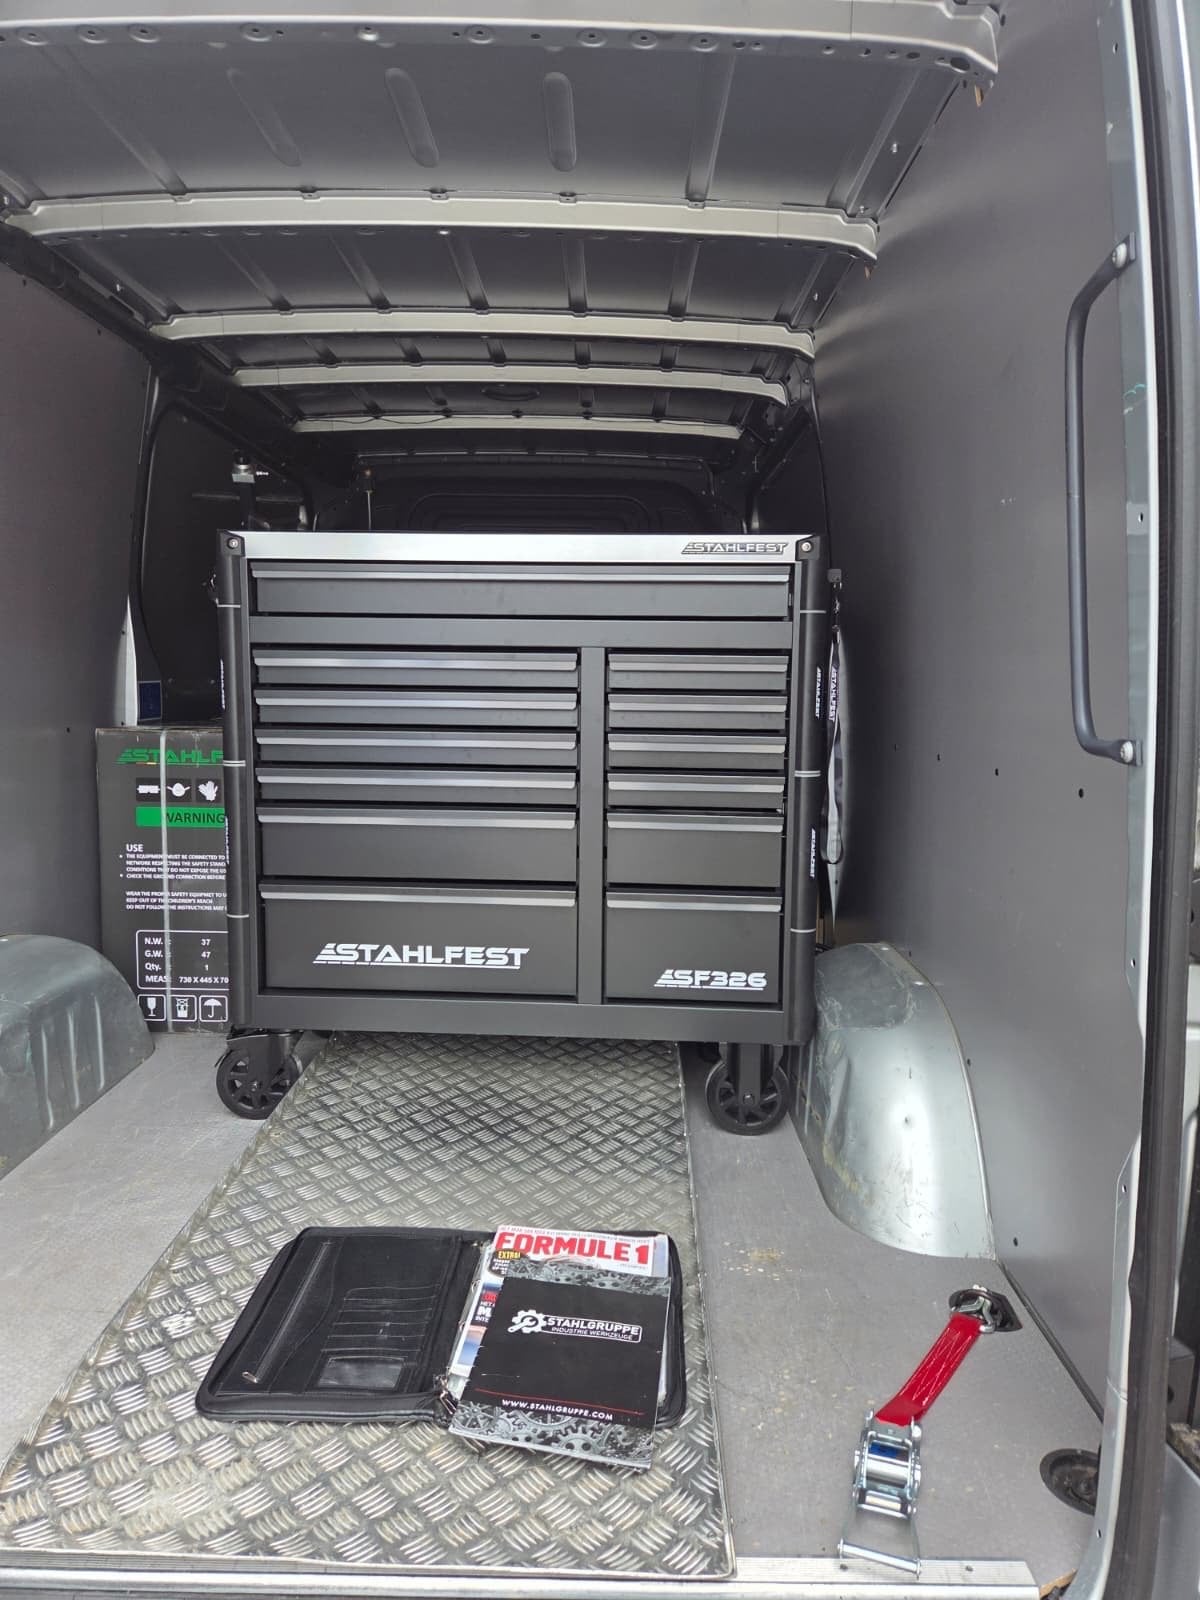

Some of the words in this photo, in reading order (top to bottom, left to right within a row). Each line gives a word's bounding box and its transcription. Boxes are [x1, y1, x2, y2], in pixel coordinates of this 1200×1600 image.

[681, 542, 788, 555] STAHLFEST
[126, 843, 144, 852] USE
[200, 938, 211, 946] 37
[200, 951, 211, 959] 47
[312, 943, 530, 969] STAHLFEST
[204, 964, 209, 972] 1
[179, 976, 192, 984] 730
[192, 976, 199, 984] X
[199, 976, 213, 984] 445
[213, 976, 220, 984] X
[654, 969, 767, 990] SF326
[495, 1231, 630, 1262] FORMULE
[635, 1244, 650, 1265] 1
[547, 1317, 640, 1335] STAHLGRUPPE
[551, 1327, 588, 1336] INDUSTRIE
[590, 1330, 633, 1341] WERKZEUGE
[501, 1399, 614, 1421] WWW.STAHLGRUPPE.COM
